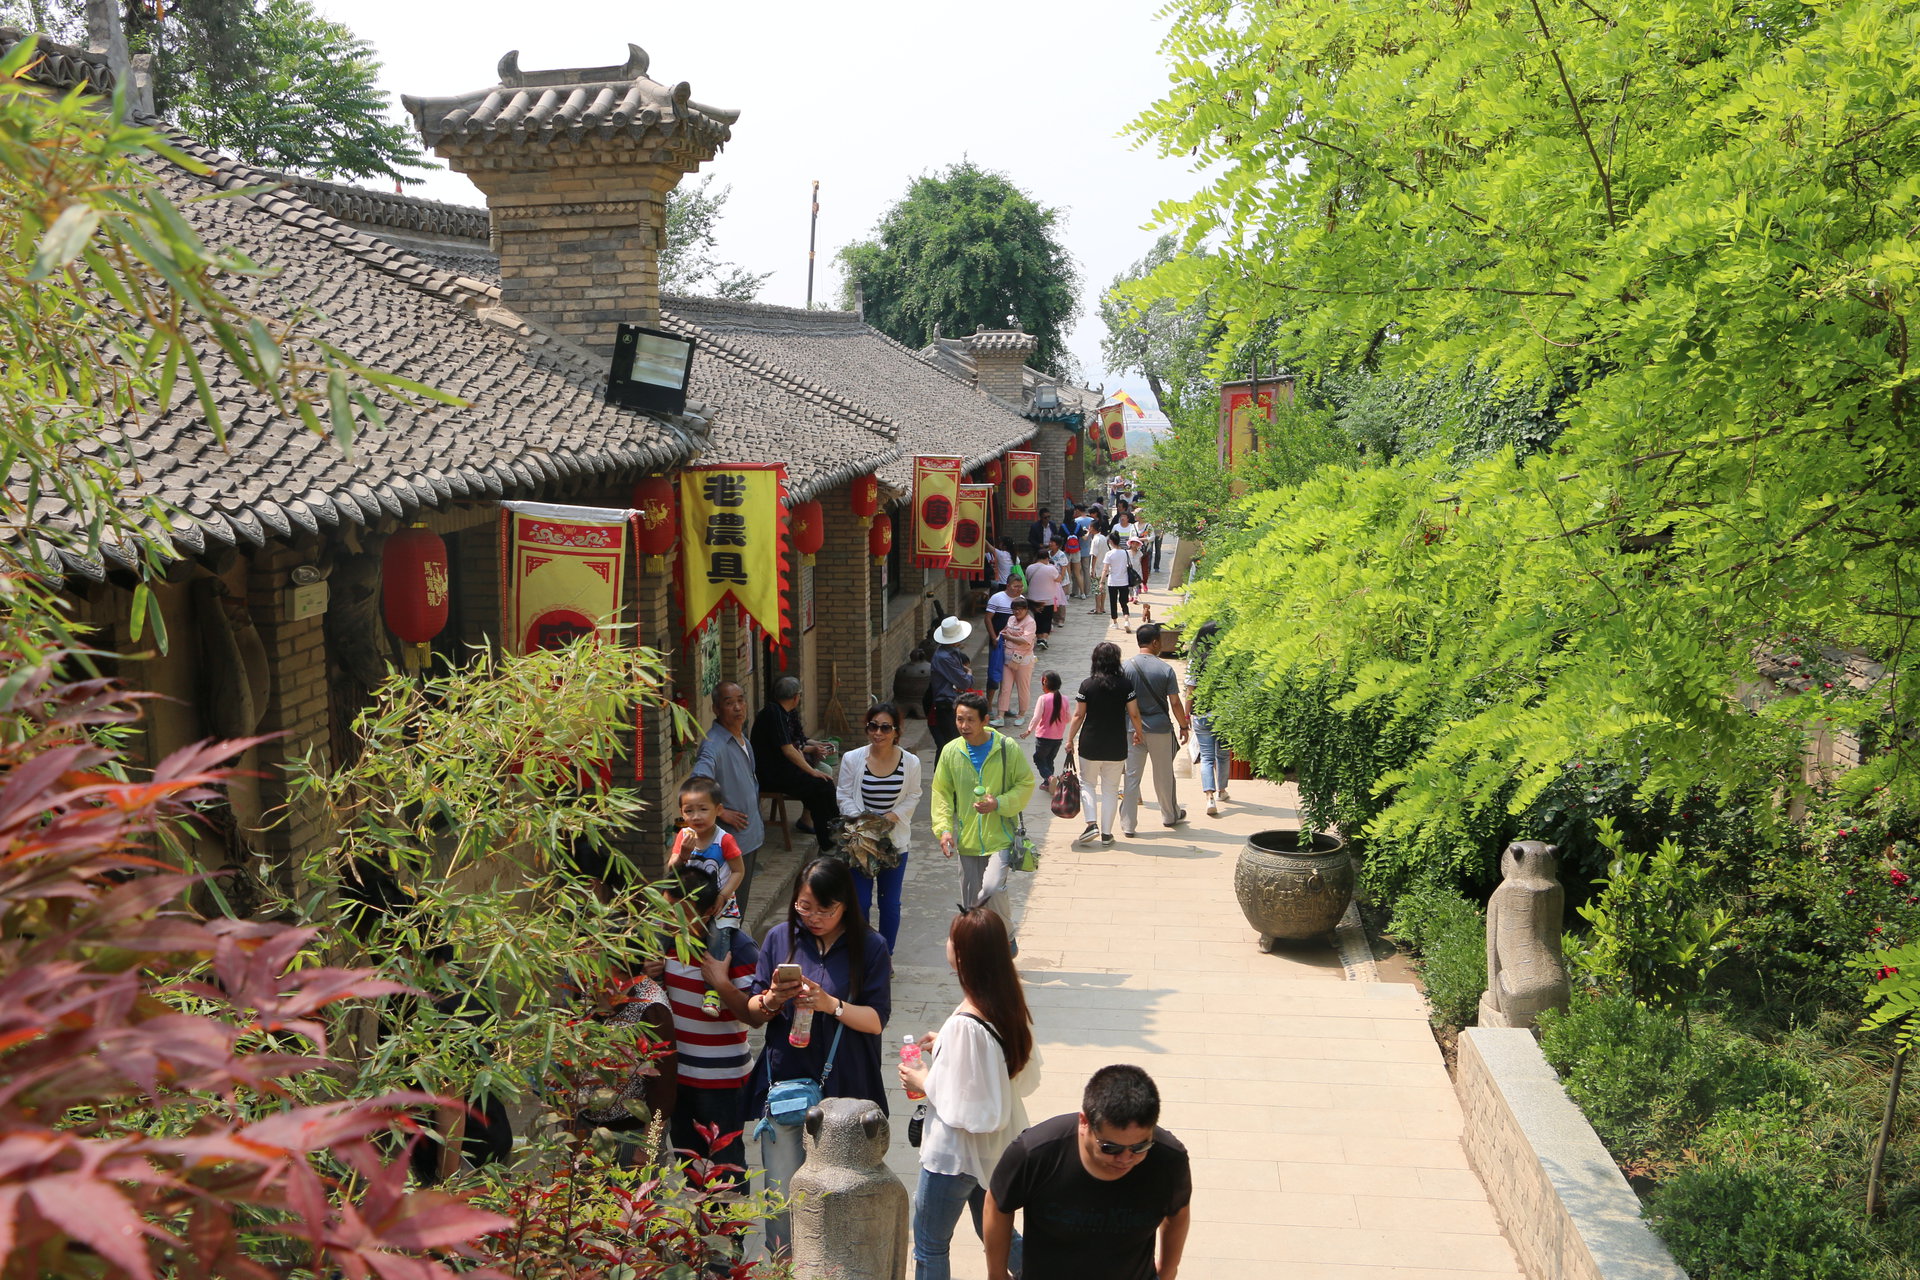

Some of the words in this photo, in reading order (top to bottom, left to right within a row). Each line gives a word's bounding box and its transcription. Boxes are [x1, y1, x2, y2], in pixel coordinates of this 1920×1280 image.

[703, 473, 748, 586] 老農具
[925, 499, 950, 525] 唐
